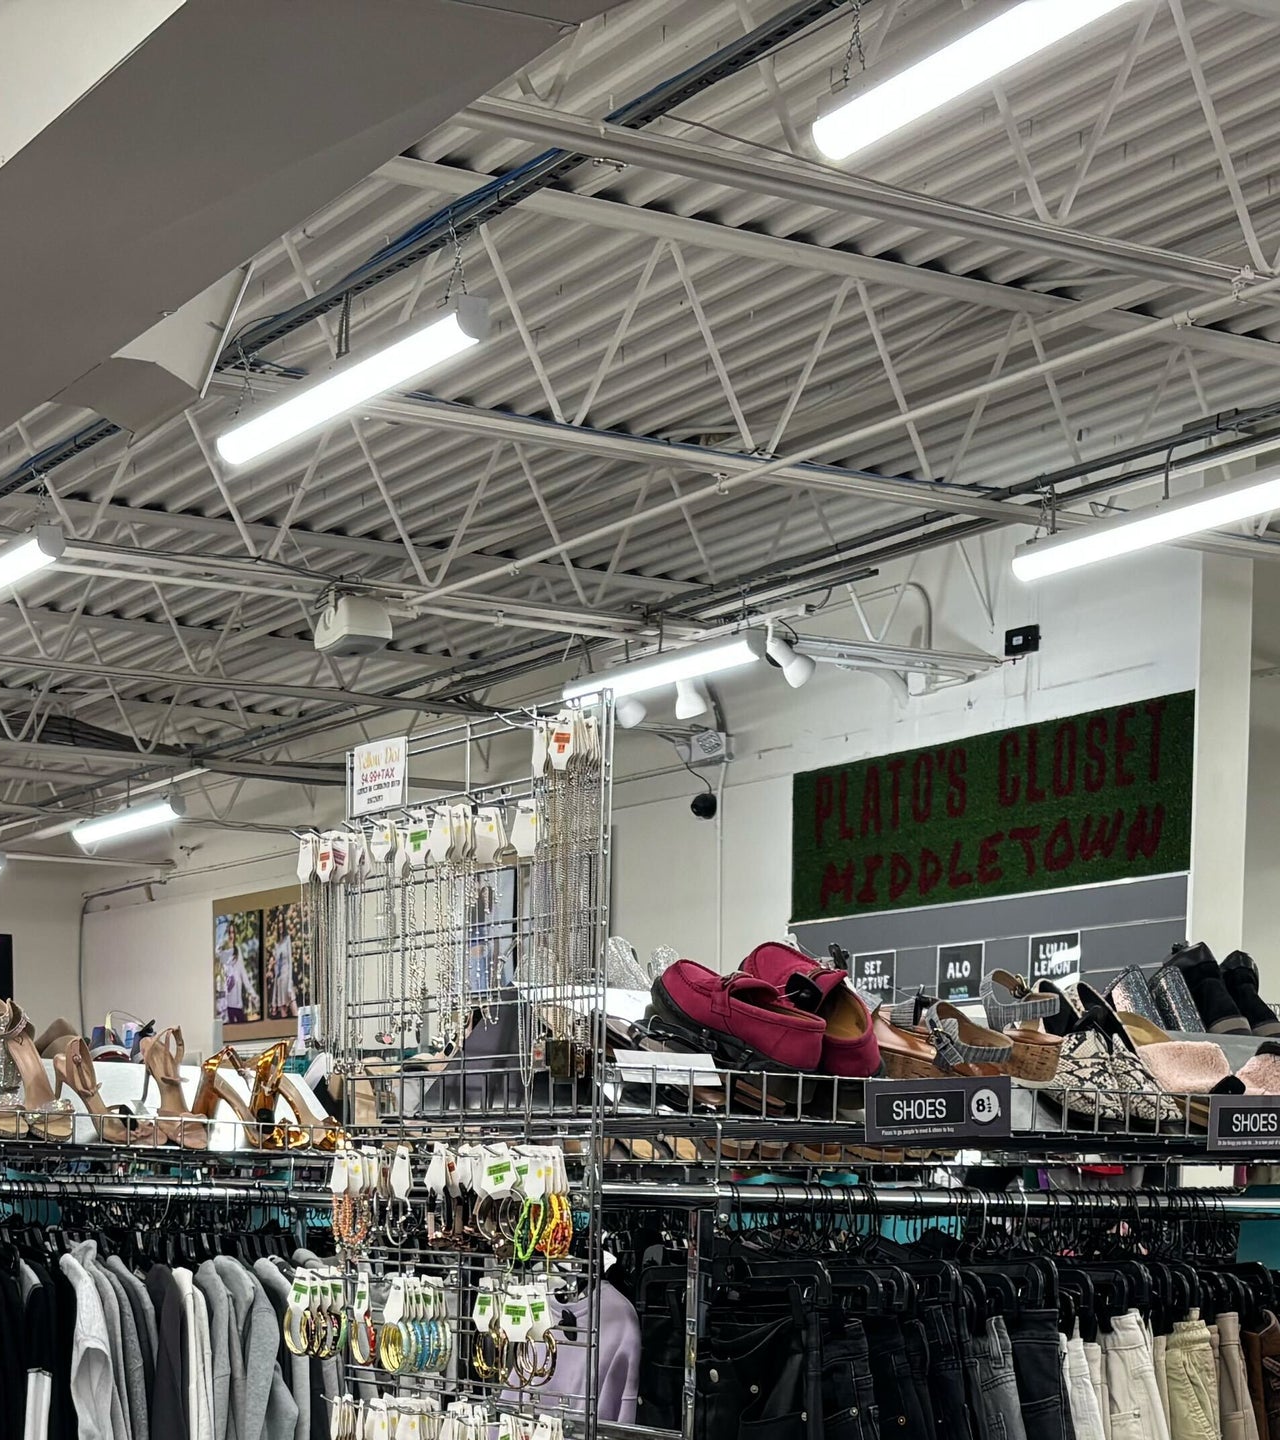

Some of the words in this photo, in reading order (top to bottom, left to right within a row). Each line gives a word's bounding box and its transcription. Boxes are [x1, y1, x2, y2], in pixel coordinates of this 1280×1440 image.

[814, 747, 968, 847] PLATO'S
[998, 703, 1167, 808] CLOSET
[820, 803, 1166, 910] MIDDLETOWN
[864, 960, 882, 975] SET
[946, 960, 971, 979] ALO
[893, 1098, 947, 1121] SHOES
[1232, 1113, 1278, 1132] SHOES
